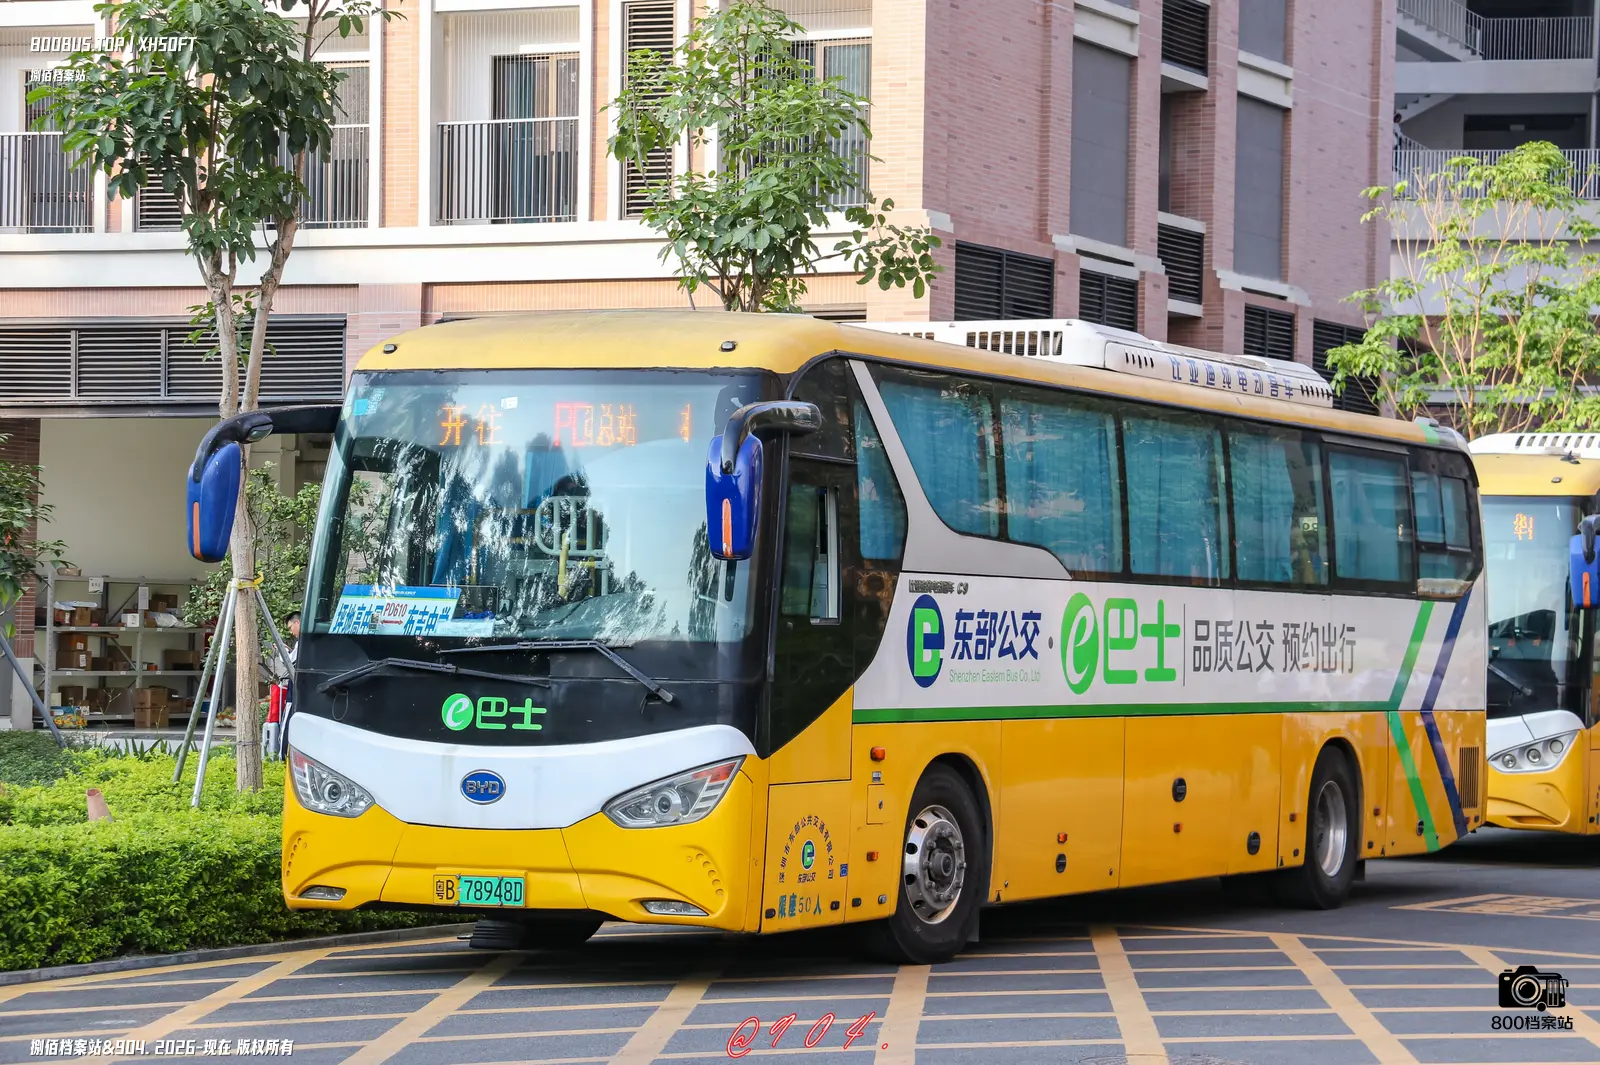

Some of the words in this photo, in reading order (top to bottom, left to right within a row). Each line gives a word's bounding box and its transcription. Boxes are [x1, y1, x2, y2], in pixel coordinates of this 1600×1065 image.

[1168, 355, 1294, 399] 比亚迪纯电动客车
[439, 402, 504, 446] 开往
[382, 602, 407, 617] PD610
[950, 608, 1042, 660] 东部公交
[1192, 619, 1275, 673] 品质公交
[1282, 622, 1356, 674] 预约出行
[949, 669, 980, 682] Shenzhen
[981, 669, 1005, 682] Eastern
[1006, 669, 1018, 682] Bus
[466, 780, 499, 794] BYD
[464, 880, 522, 902] 78948D
